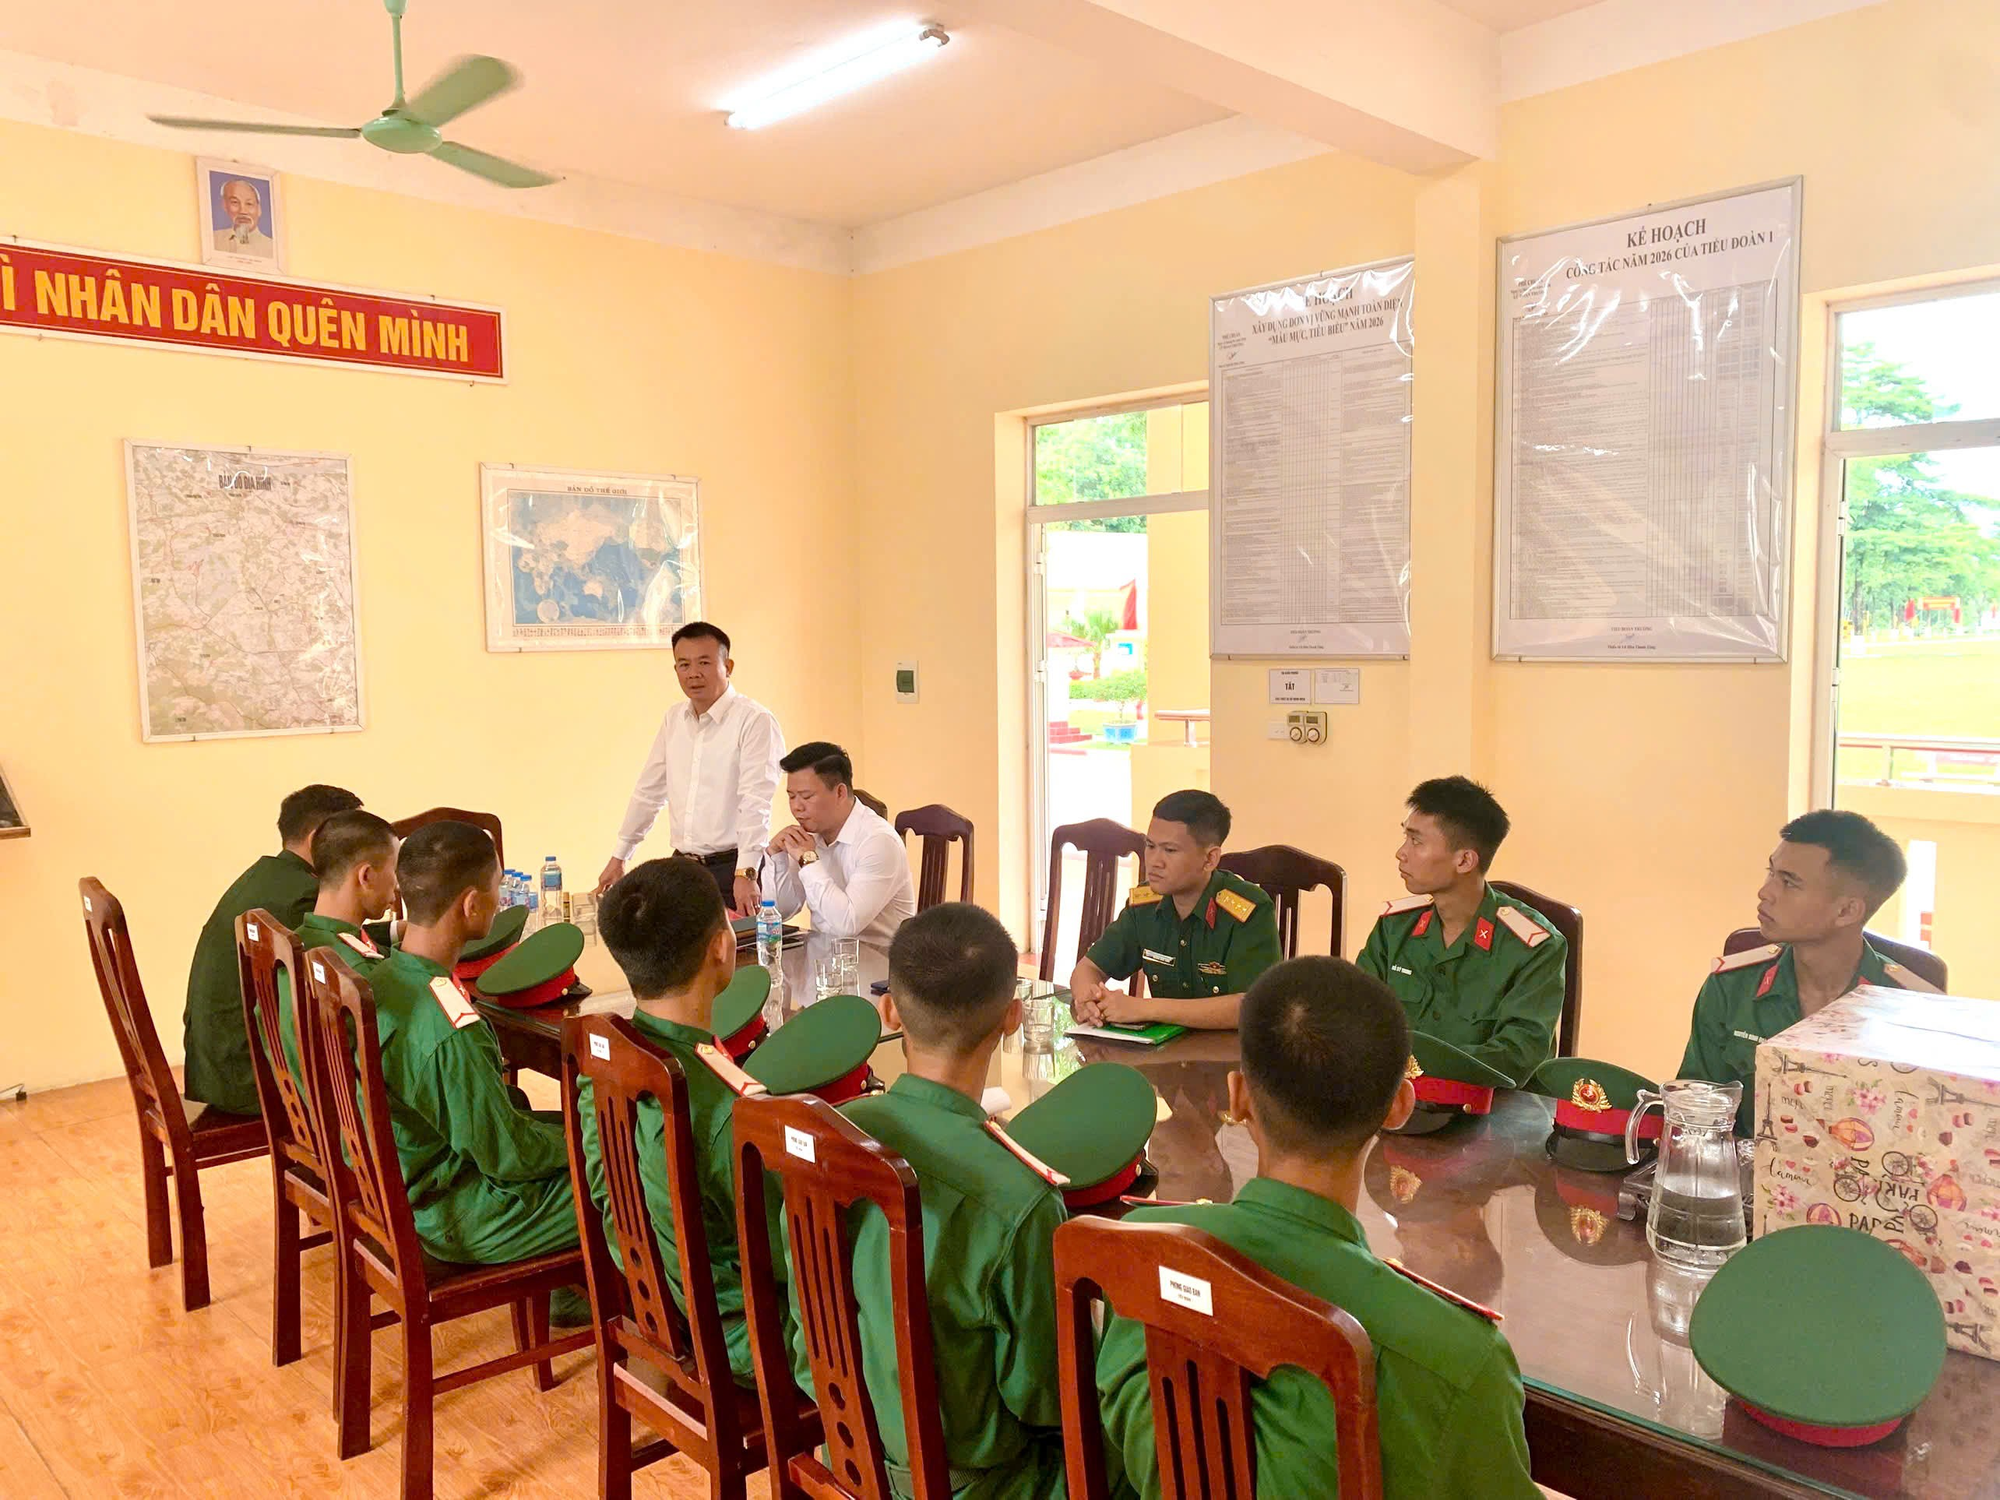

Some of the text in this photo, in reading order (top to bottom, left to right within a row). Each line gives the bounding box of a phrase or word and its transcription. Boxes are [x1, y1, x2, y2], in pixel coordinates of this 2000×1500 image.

[1627, 218, 1706, 248] KẾ HOẠCH
[1599, 257, 1620, 274] TÁC
[1622, 253, 1648, 269] NĂM
[1650, 250, 1672, 265] 2026
[1675, 243, 1698, 260] CỦA
[1701, 236, 1728, 255] TIỂU
[1731, 231, 1765, 250] ĐOÀN
[35, 268, 162, 328] NHÂN
[172, 283, 256, 339] DÂN
[267, 298, 366, 351] QUÊN
[379, 309, 469, 362] MÌNH
[1337, 305, 1360, 320] MẠNH
[1362, 299, 1382, 315] TOÀN
[1350, 318, 1367, 331] NĂM
[1369, 316, 1384, 328] 2026
